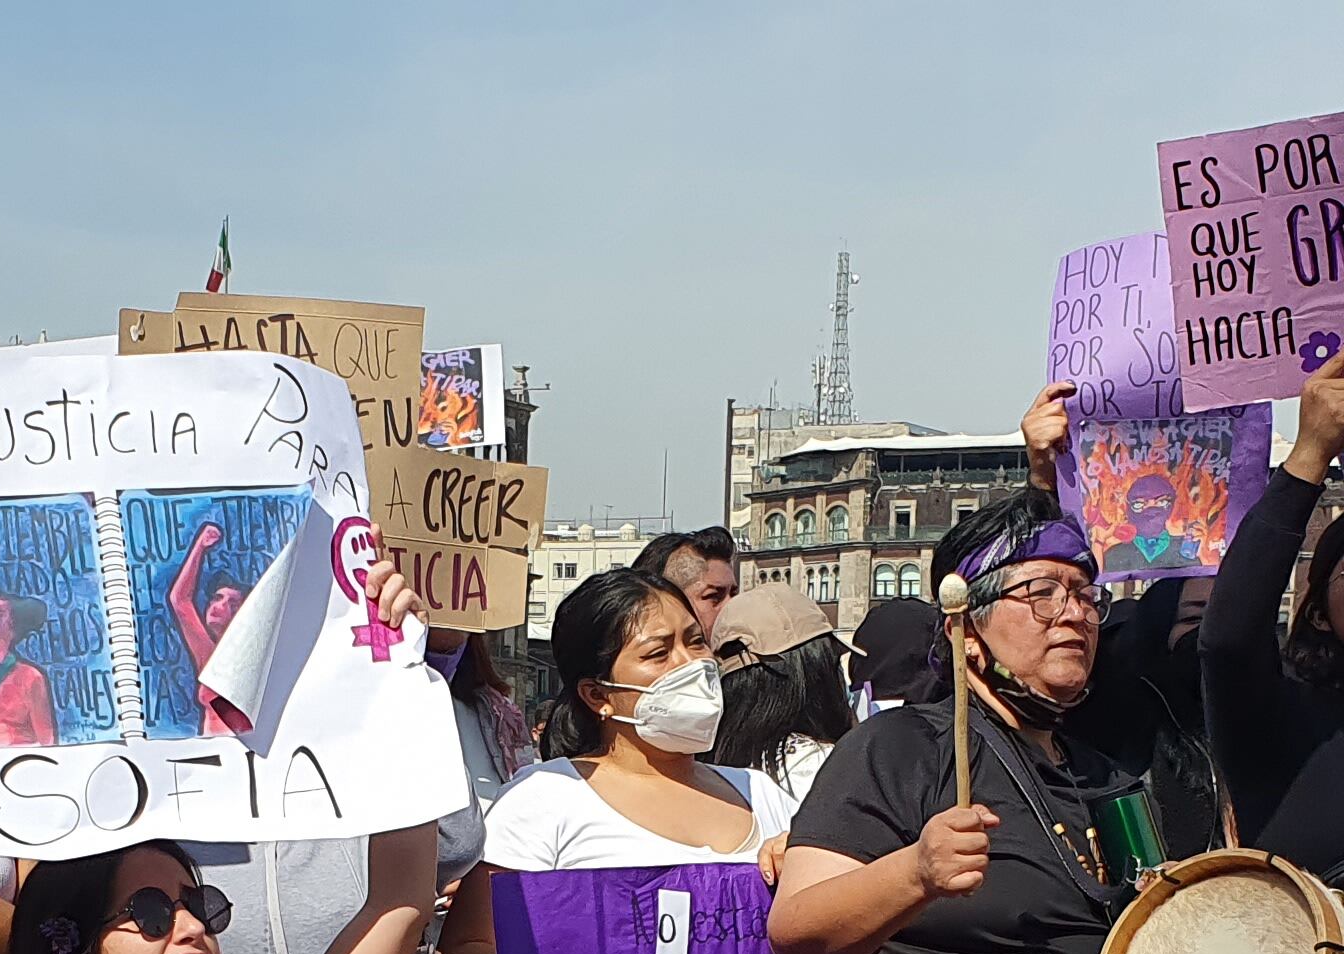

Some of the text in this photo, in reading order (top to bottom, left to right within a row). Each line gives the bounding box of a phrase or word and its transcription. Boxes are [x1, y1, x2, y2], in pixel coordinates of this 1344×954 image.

[1172, 156, 1222, 212] ES
[1256, 132, 1339, 194] POR
[1190, 211, 1263, 259] QUE
[1063, 242, 1124, 296] HOY
[1191, 253, 1257, 299] HOY
[1053, 293, 1103, 340] POR
[1184, 305, 1297, 366] HACIA
[334, 322, 400, 381] QUE
[1051, 335, 1104, 383] POR
[127, 497, 194, 563] QUE
[385, 467, 528, 543] A CREER
[132, 564, 164, 616] EL
[137, 613, 181, 667] LOS
[143, 666, 191, 728] LAS
